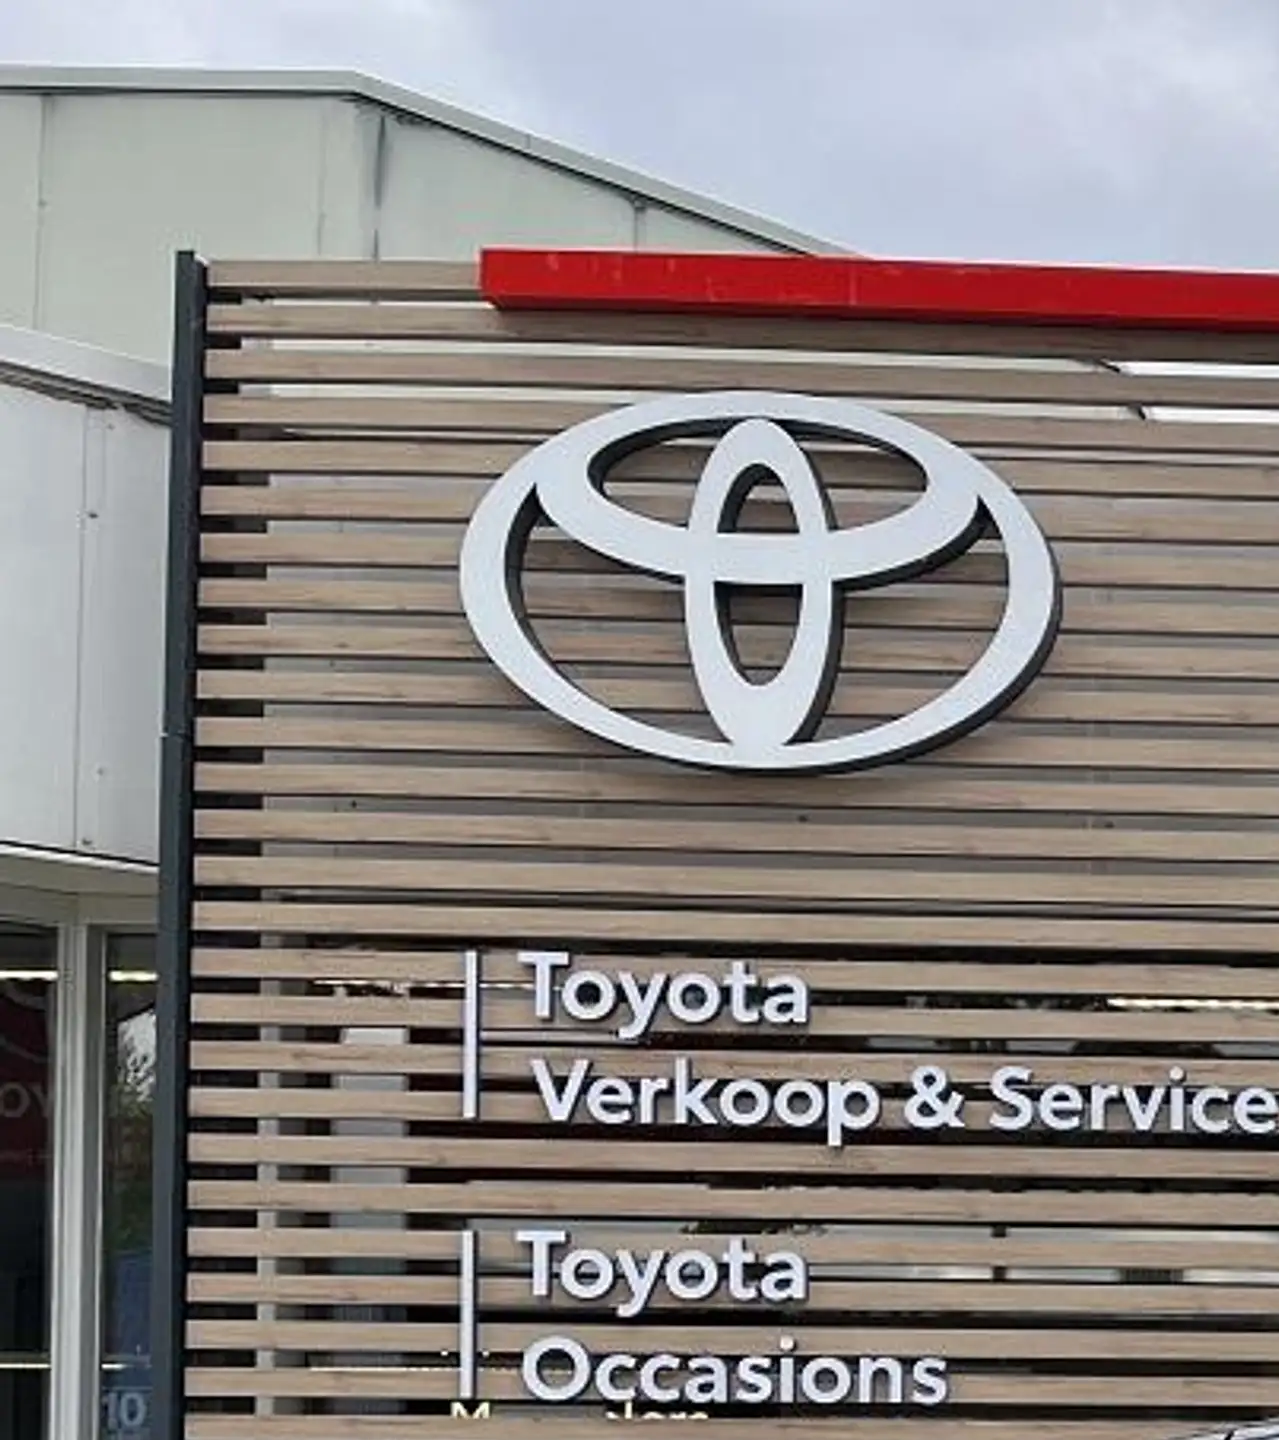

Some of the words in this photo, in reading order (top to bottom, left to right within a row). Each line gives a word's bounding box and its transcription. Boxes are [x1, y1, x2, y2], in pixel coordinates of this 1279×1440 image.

[517, 951, 809, 1040] Toyota
[531, 1057, 881, 1147] Verkoop
[904, 1065, 966, 1129] &
[516, 1230, 809, 1318] Toyota
[521, 1335, 949, 1404] Occasions
